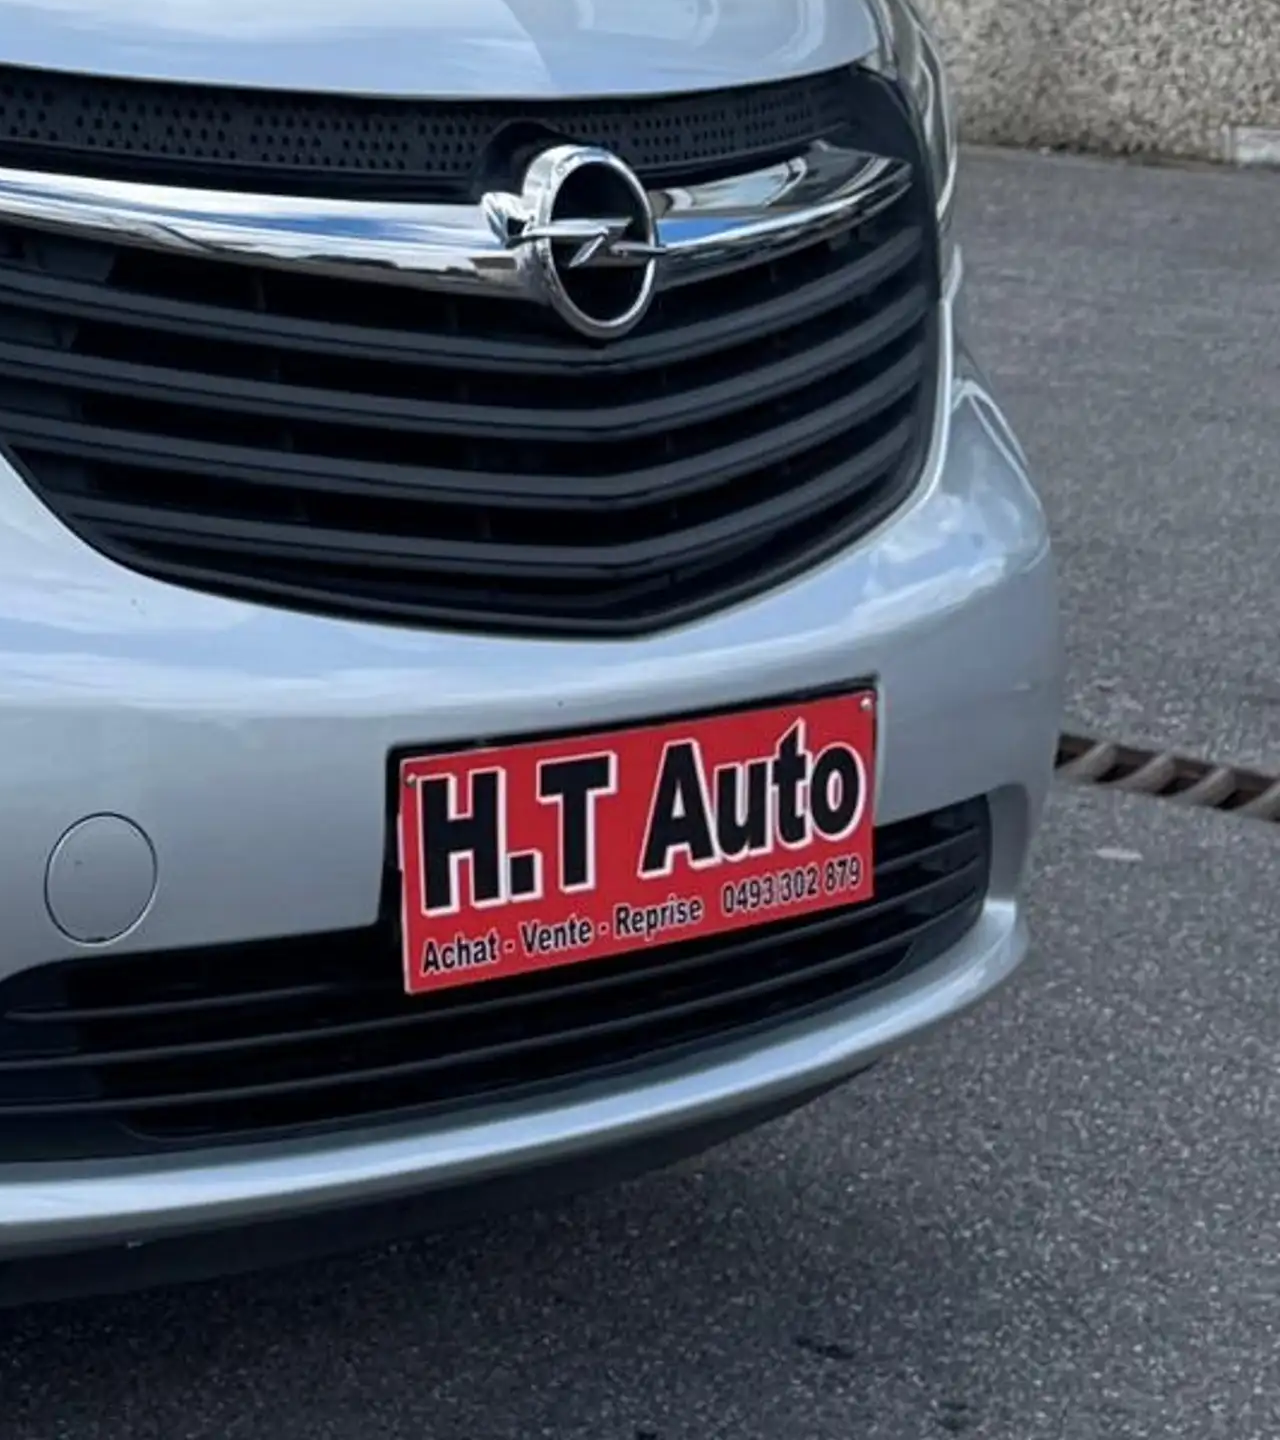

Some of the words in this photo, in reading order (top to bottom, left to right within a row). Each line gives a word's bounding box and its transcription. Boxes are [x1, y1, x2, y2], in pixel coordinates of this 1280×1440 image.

[419, 752, 617, 916] H.T
[638, 718, 866, 878] Auto
[422, 930, 498, 975] Achat
[521, 913, 592, 954] Vente
[615, 895, 703, 940] Reprise
[823, 854, 862, 894] 879
